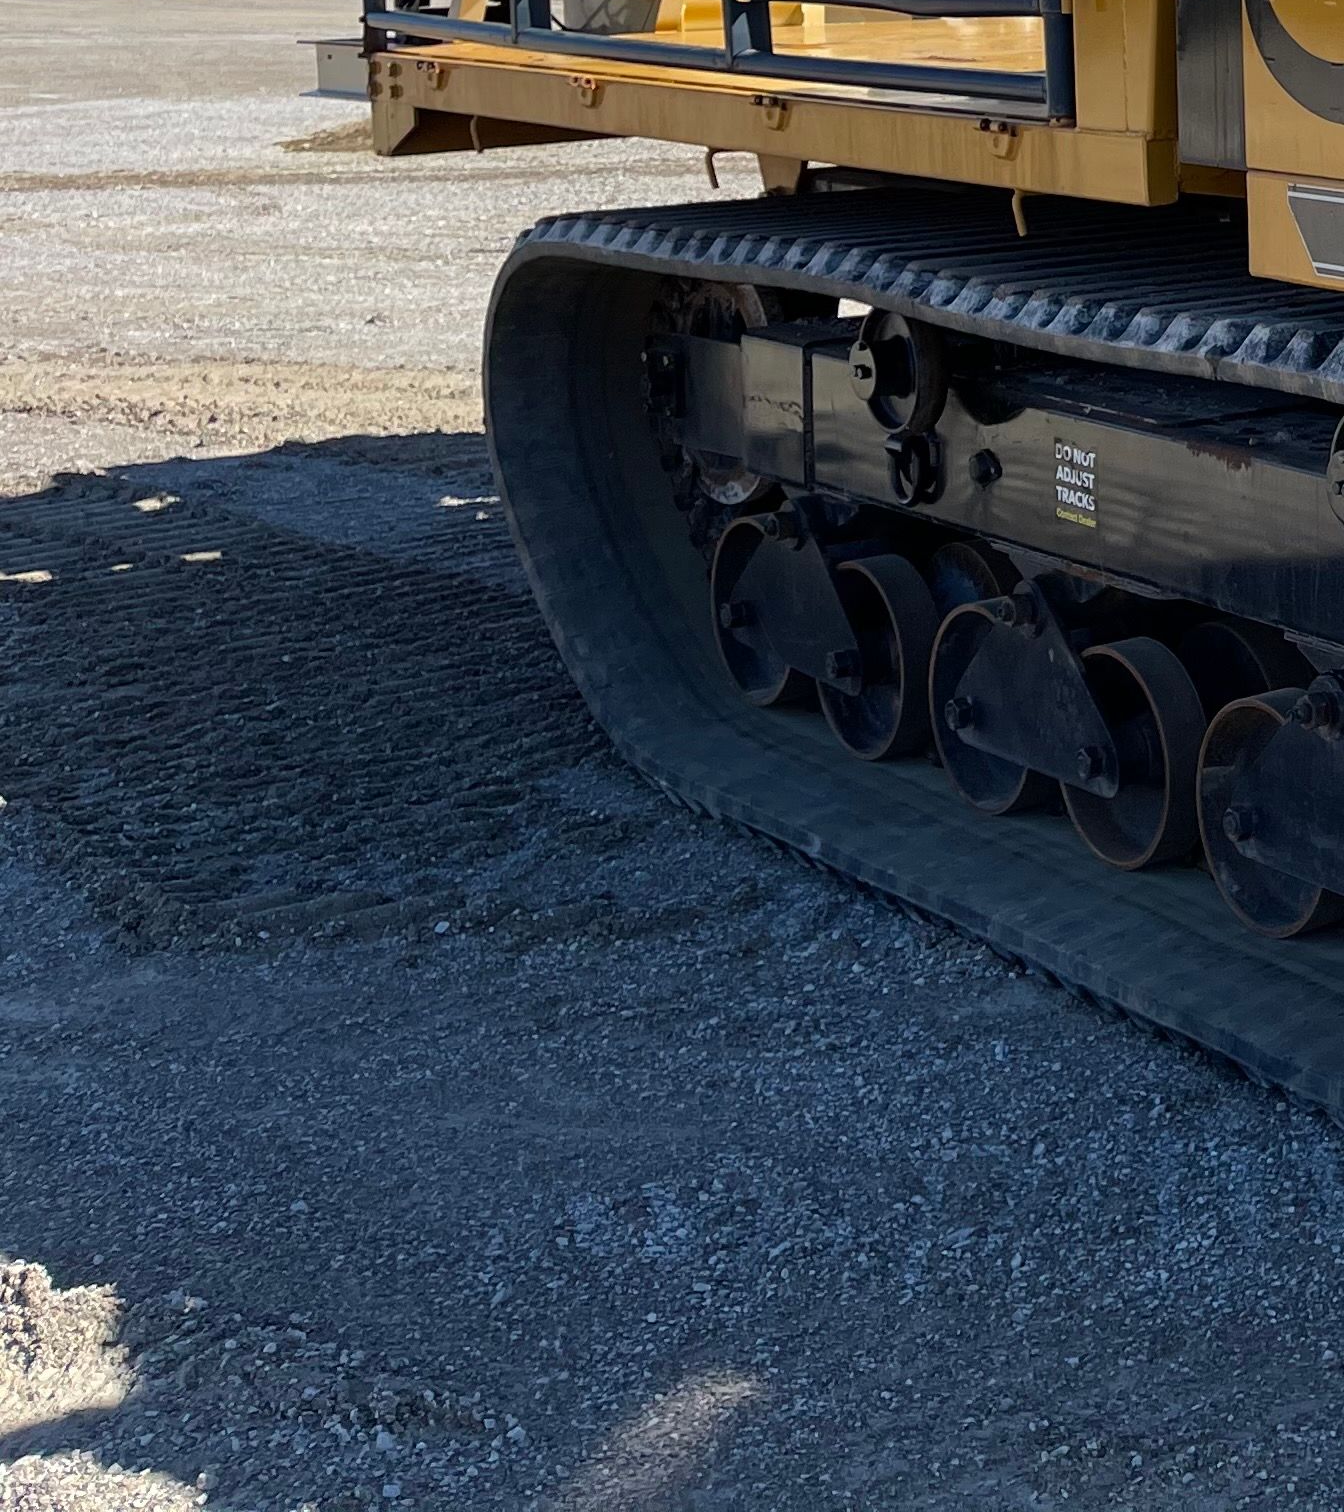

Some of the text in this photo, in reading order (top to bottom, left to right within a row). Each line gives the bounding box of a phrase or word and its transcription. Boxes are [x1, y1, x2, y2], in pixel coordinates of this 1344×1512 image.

[1055, 443, 1096, 469] DO NOT
[1055, 465, 1095, 489] ADJUST
[1055, 485, 1095, 511] TRACKS
